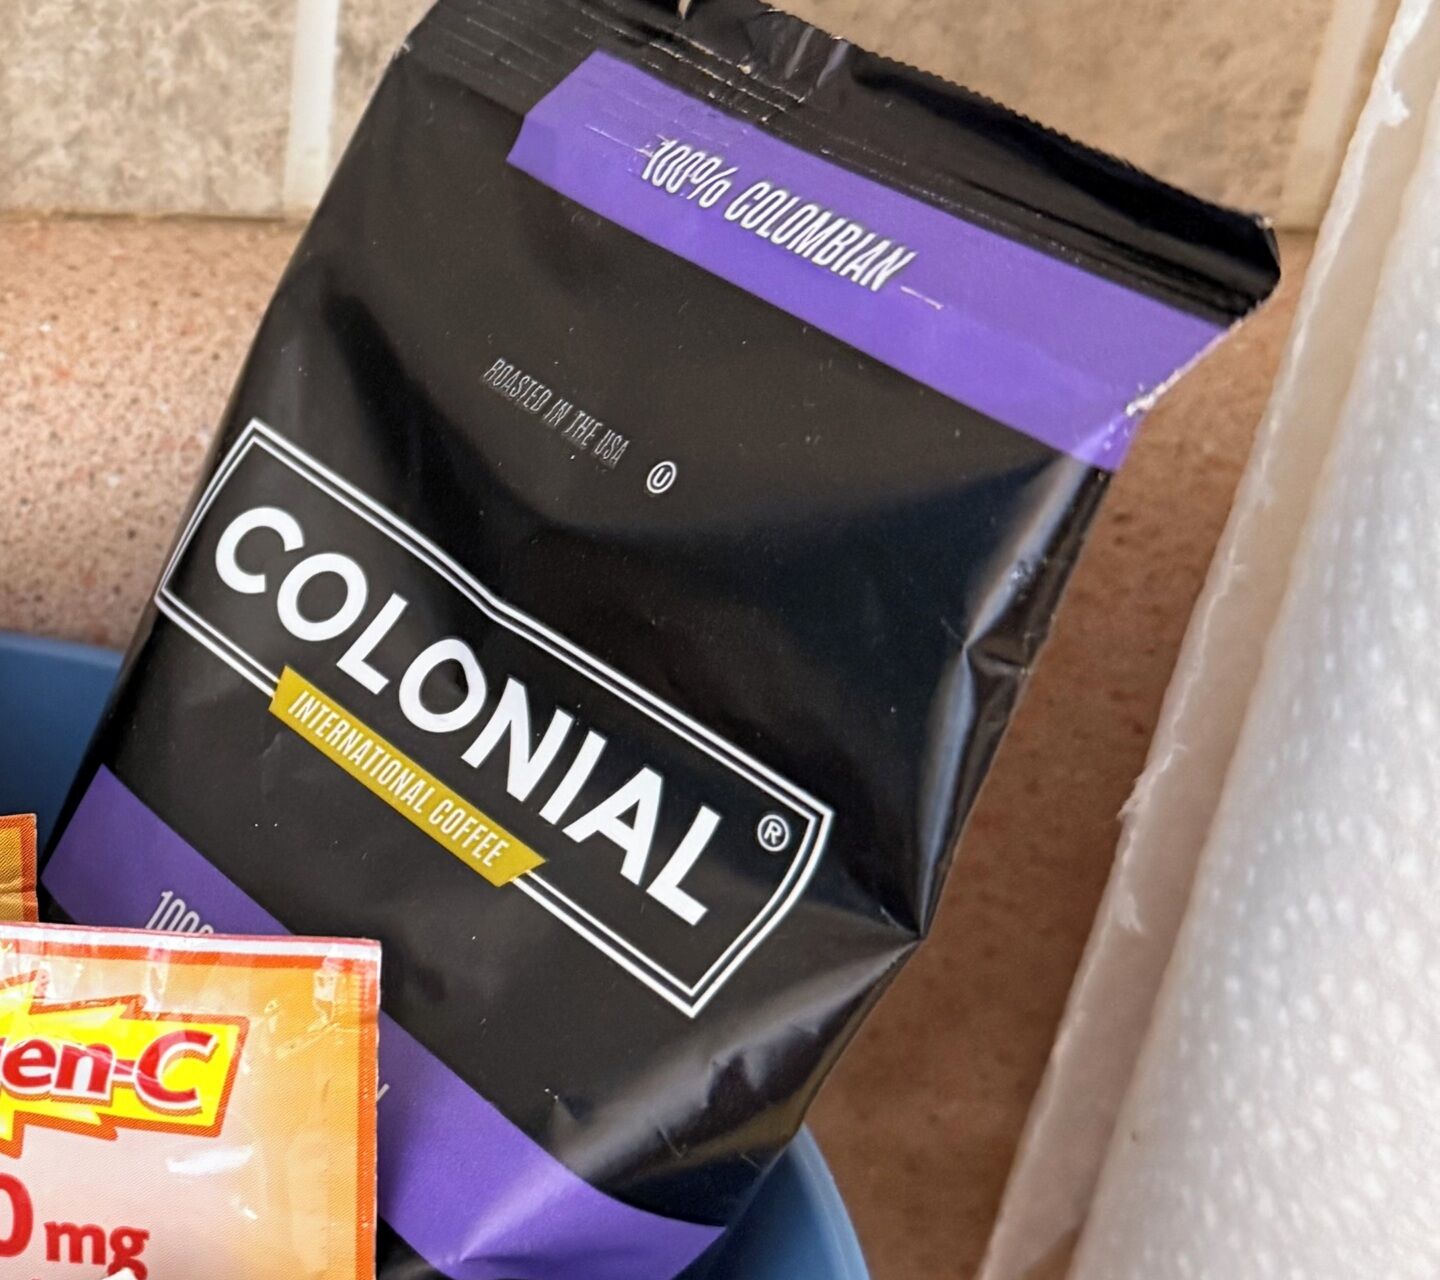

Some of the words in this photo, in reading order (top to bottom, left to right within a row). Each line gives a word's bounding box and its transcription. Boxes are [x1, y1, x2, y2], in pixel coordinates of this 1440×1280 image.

[641, 137, 739, 209] 100%
[723, 180, 919, 292] COLOMBIAN
[482, 357, 553, 413] ROASTED
[541, 398, 574, 428] IN
[563, 409, 604, 447] THE
[593, 428, 631, 469] USA
[215, 506, 719, 926] COLONIAL
[287, 689, 436, 815] INTERNATIONAL
[427, 798, 510, 868] COFFEE
